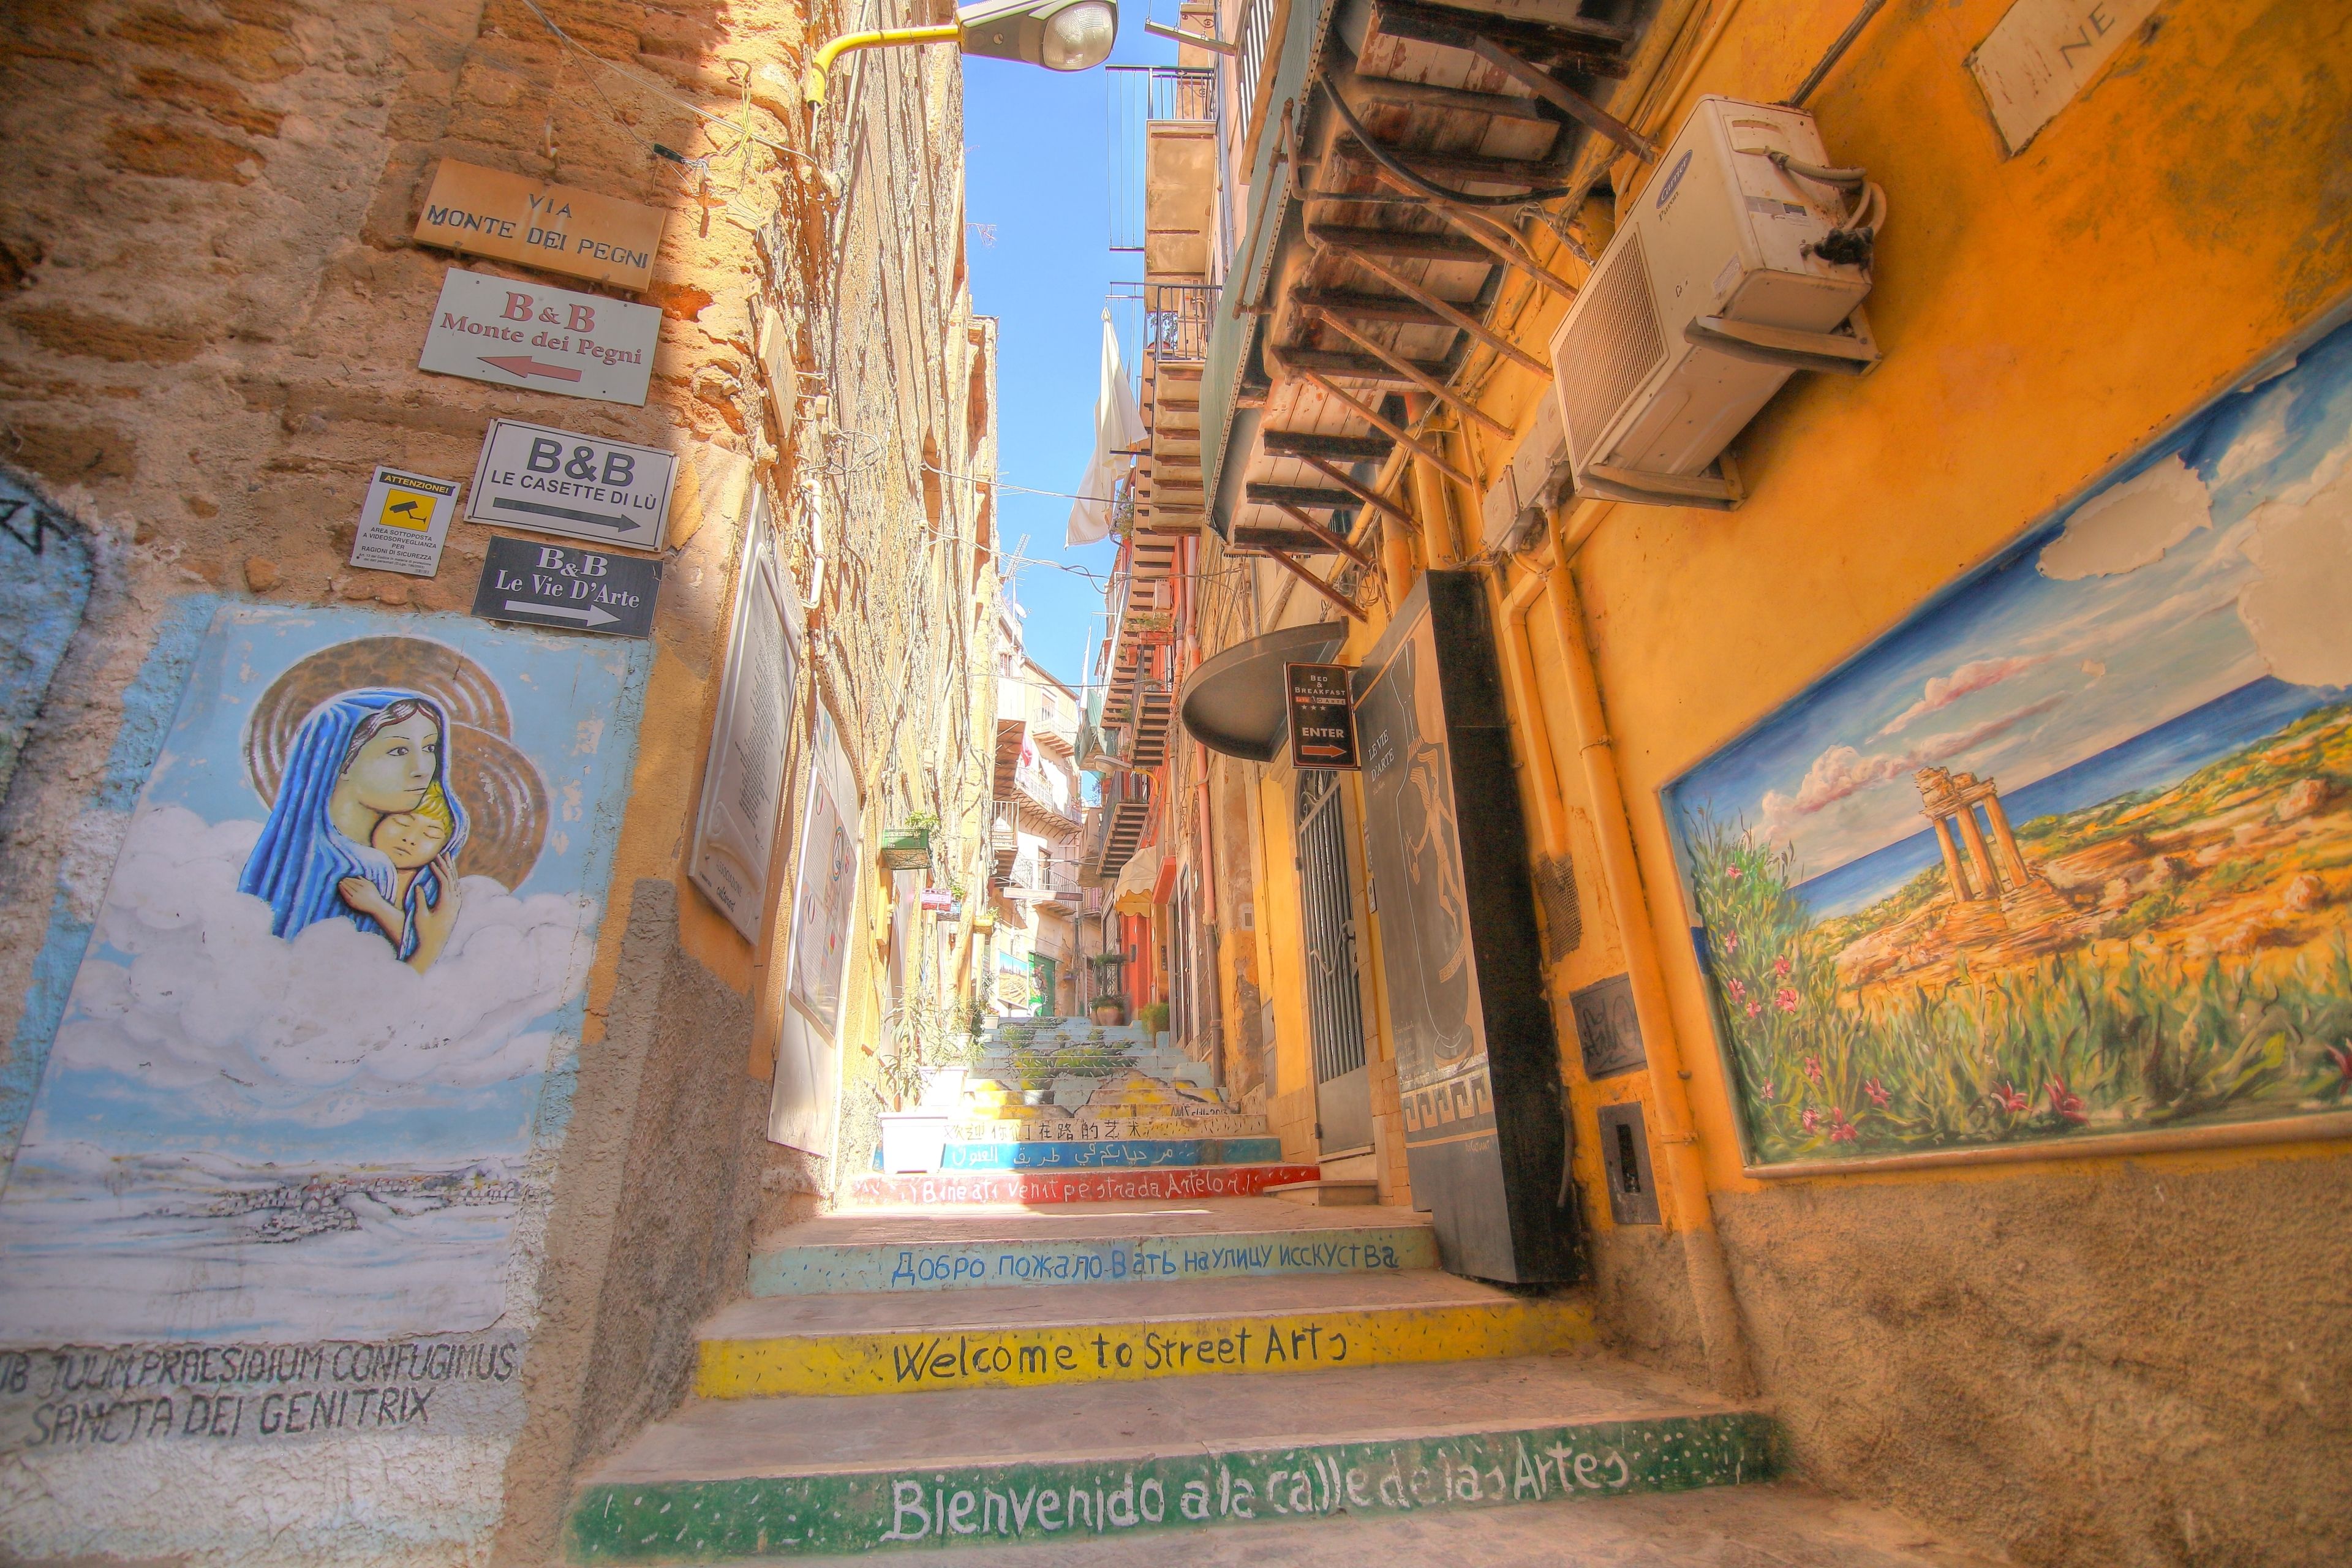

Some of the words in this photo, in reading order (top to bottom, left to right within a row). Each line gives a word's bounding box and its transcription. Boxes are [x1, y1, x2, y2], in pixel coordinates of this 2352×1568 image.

[1660, 157, 1687, 201] Carrier
[528, 193, 572, 219] VIA
[1658, 191, 1679, 222] Puron
[427, 205, 516, 238] MONTE
[527, 227, 565, 251] DEI
[577, 239, 648, 269] PEGNI
[440, 312, 525, 343] Monte
[531, 330, 570, 353] dei
[576, 338, 642, 366] Pegni
[527, 437, 636, 488] B&B
[384, 475, 449, 493] ATTENZIONE!
[491, 470, 515, 487] LE
[520, 475, 605, 502] CASETTE
[610, 491, 629, 507] DI
[633, 492, 657, 511] LÙ
[369, 533, 437, 549] VIDEOSORVEGLIANZA
[390, 530, 432, 541] SOTTOPOSTA
[361, 546, 388, 554] RAGIONI
[397, 550, 432, 561] SICUREZZA
[536, 548, 609, 578] B&B
[495, 570, 524, 593] Le
[531, 574, 563, 598] Vie
[570, 580, 640, 609] D'Arte
[1302, 727, 1344, 738] ENTER
[1368, 743, 1378, 761] LE
[1376, 729, 1389, 750] VIE
[1371, 747, 1395, 783] D'ARTE
[1064, 1182, 1089, 1202] pe
[1096, 1176, 1161, 1199] strada
[891, 1252, 985, 1287] Добро
[333, 1343, 516, 1382] CONFUGIMUS
[893, 1337, 1078, 1382] Welcome
[1091, 1333, 1132, 1370] to
[1144, 1327, 1252, 1370] Street
[25, 1396, 173, 1446] SANCTA
[183, 1395, 241, 1437] DEI
[260, 1386, 436, 1434] GENITRIX
[879, 1471, 1164, 1542] Bienvenido
[1180, 1480, 1210, 1520] a
[1219, 1464, 1256, 1518] la
[1267, 1455, 1372, 1513] calle
[1513, 1436, 1629, 1501] Artes
